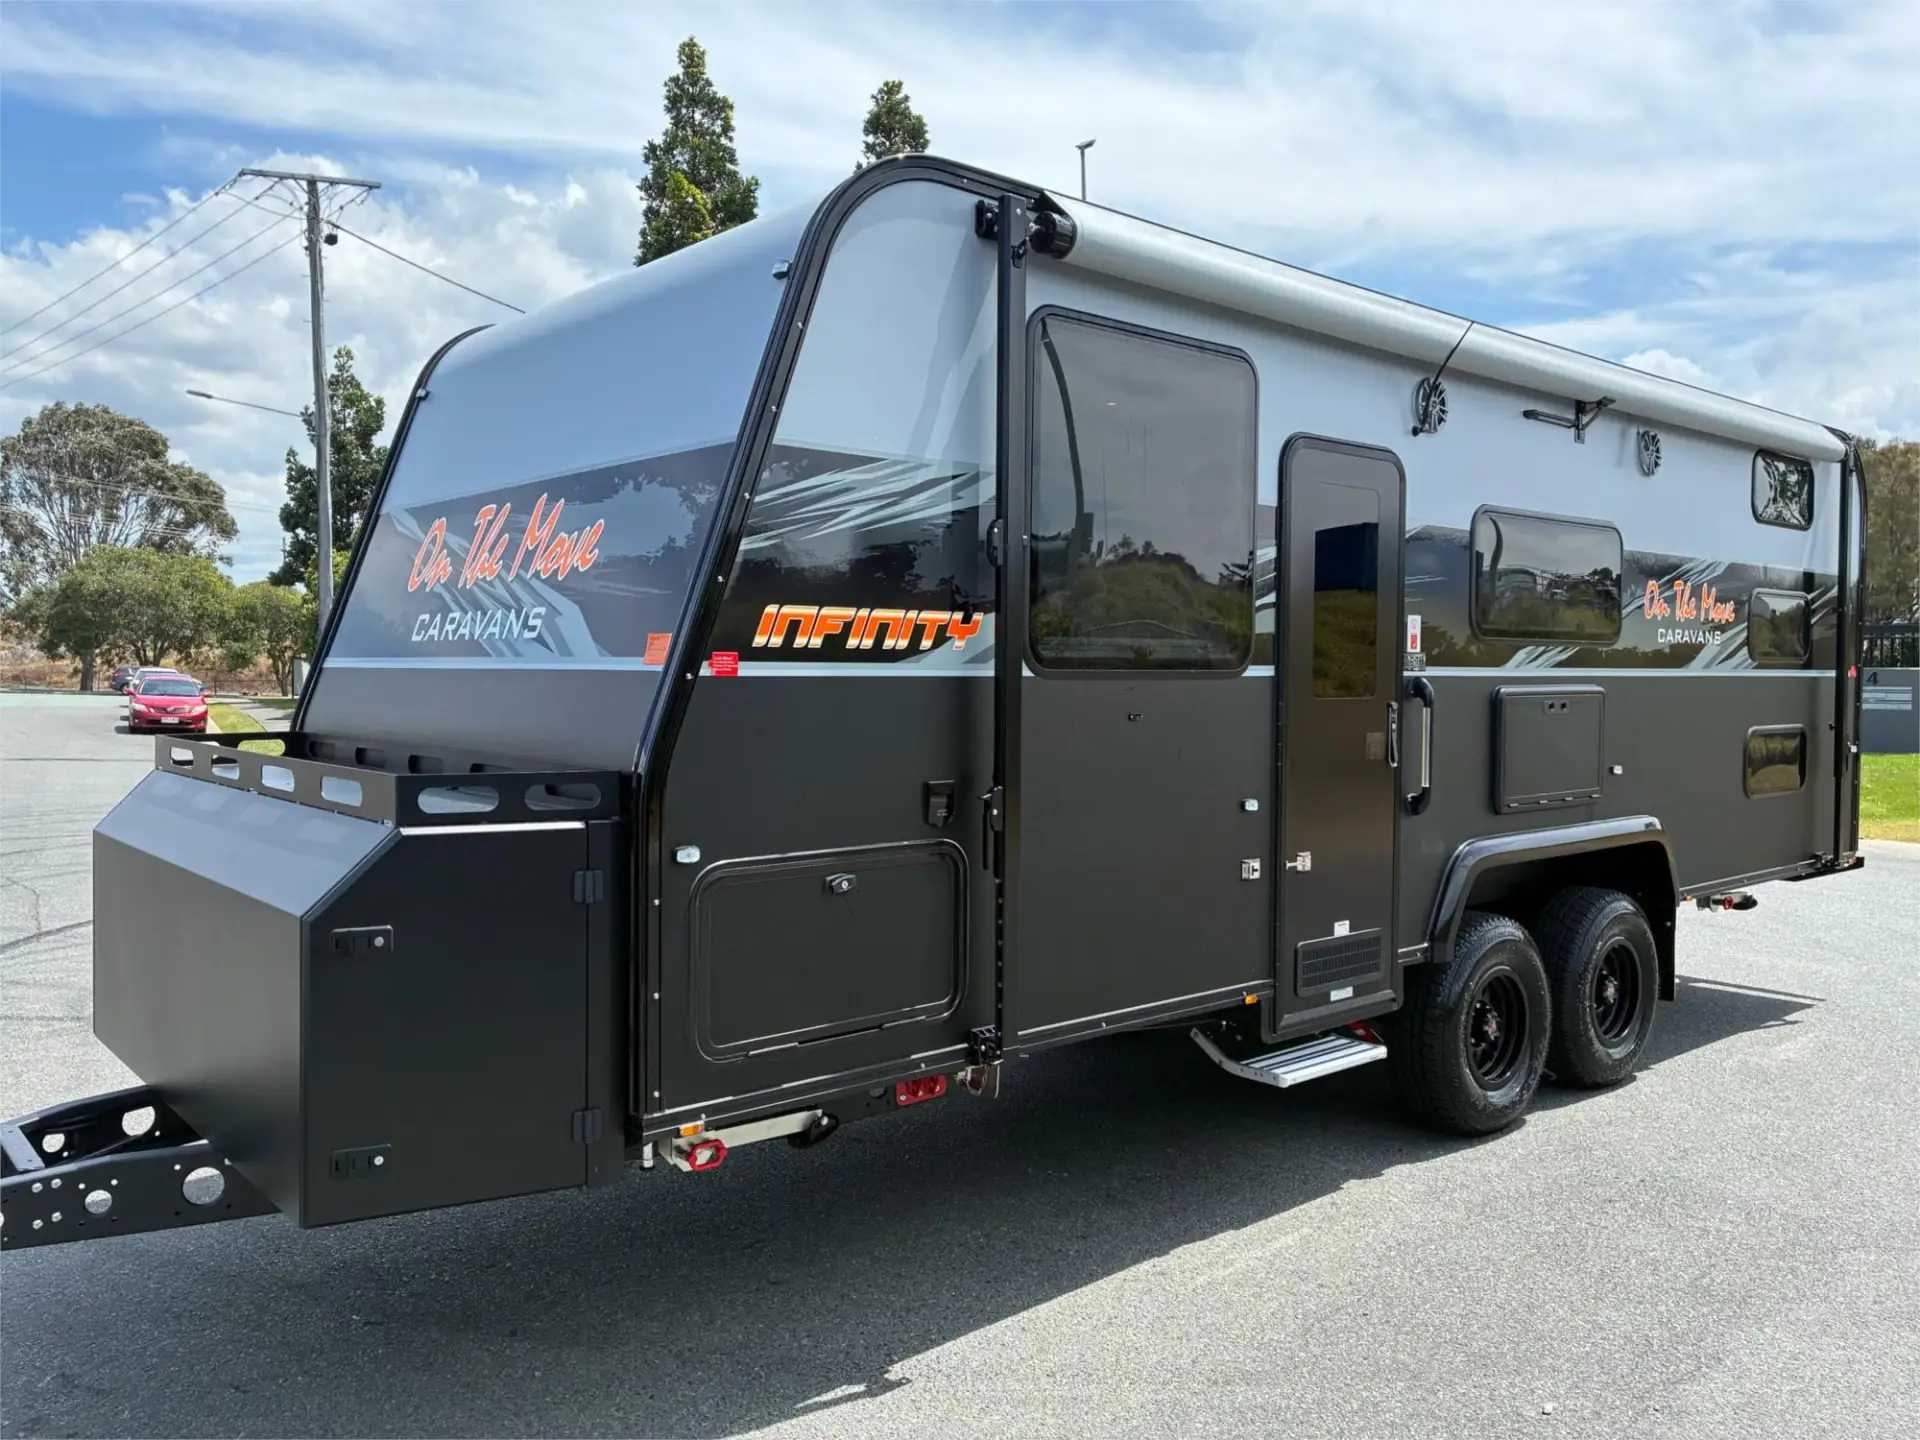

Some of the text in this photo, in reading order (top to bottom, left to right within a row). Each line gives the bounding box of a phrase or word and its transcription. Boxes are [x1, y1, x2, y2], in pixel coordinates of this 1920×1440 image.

[408, 492, 604, 592] On The Move
[411, 606, 546, 642] CARAVANS
[1643, 580, 1735, 624] On The Move
[752, 604, 984, 651] INFINITY
[1657, 628, 1722, 645] CARAVANS
